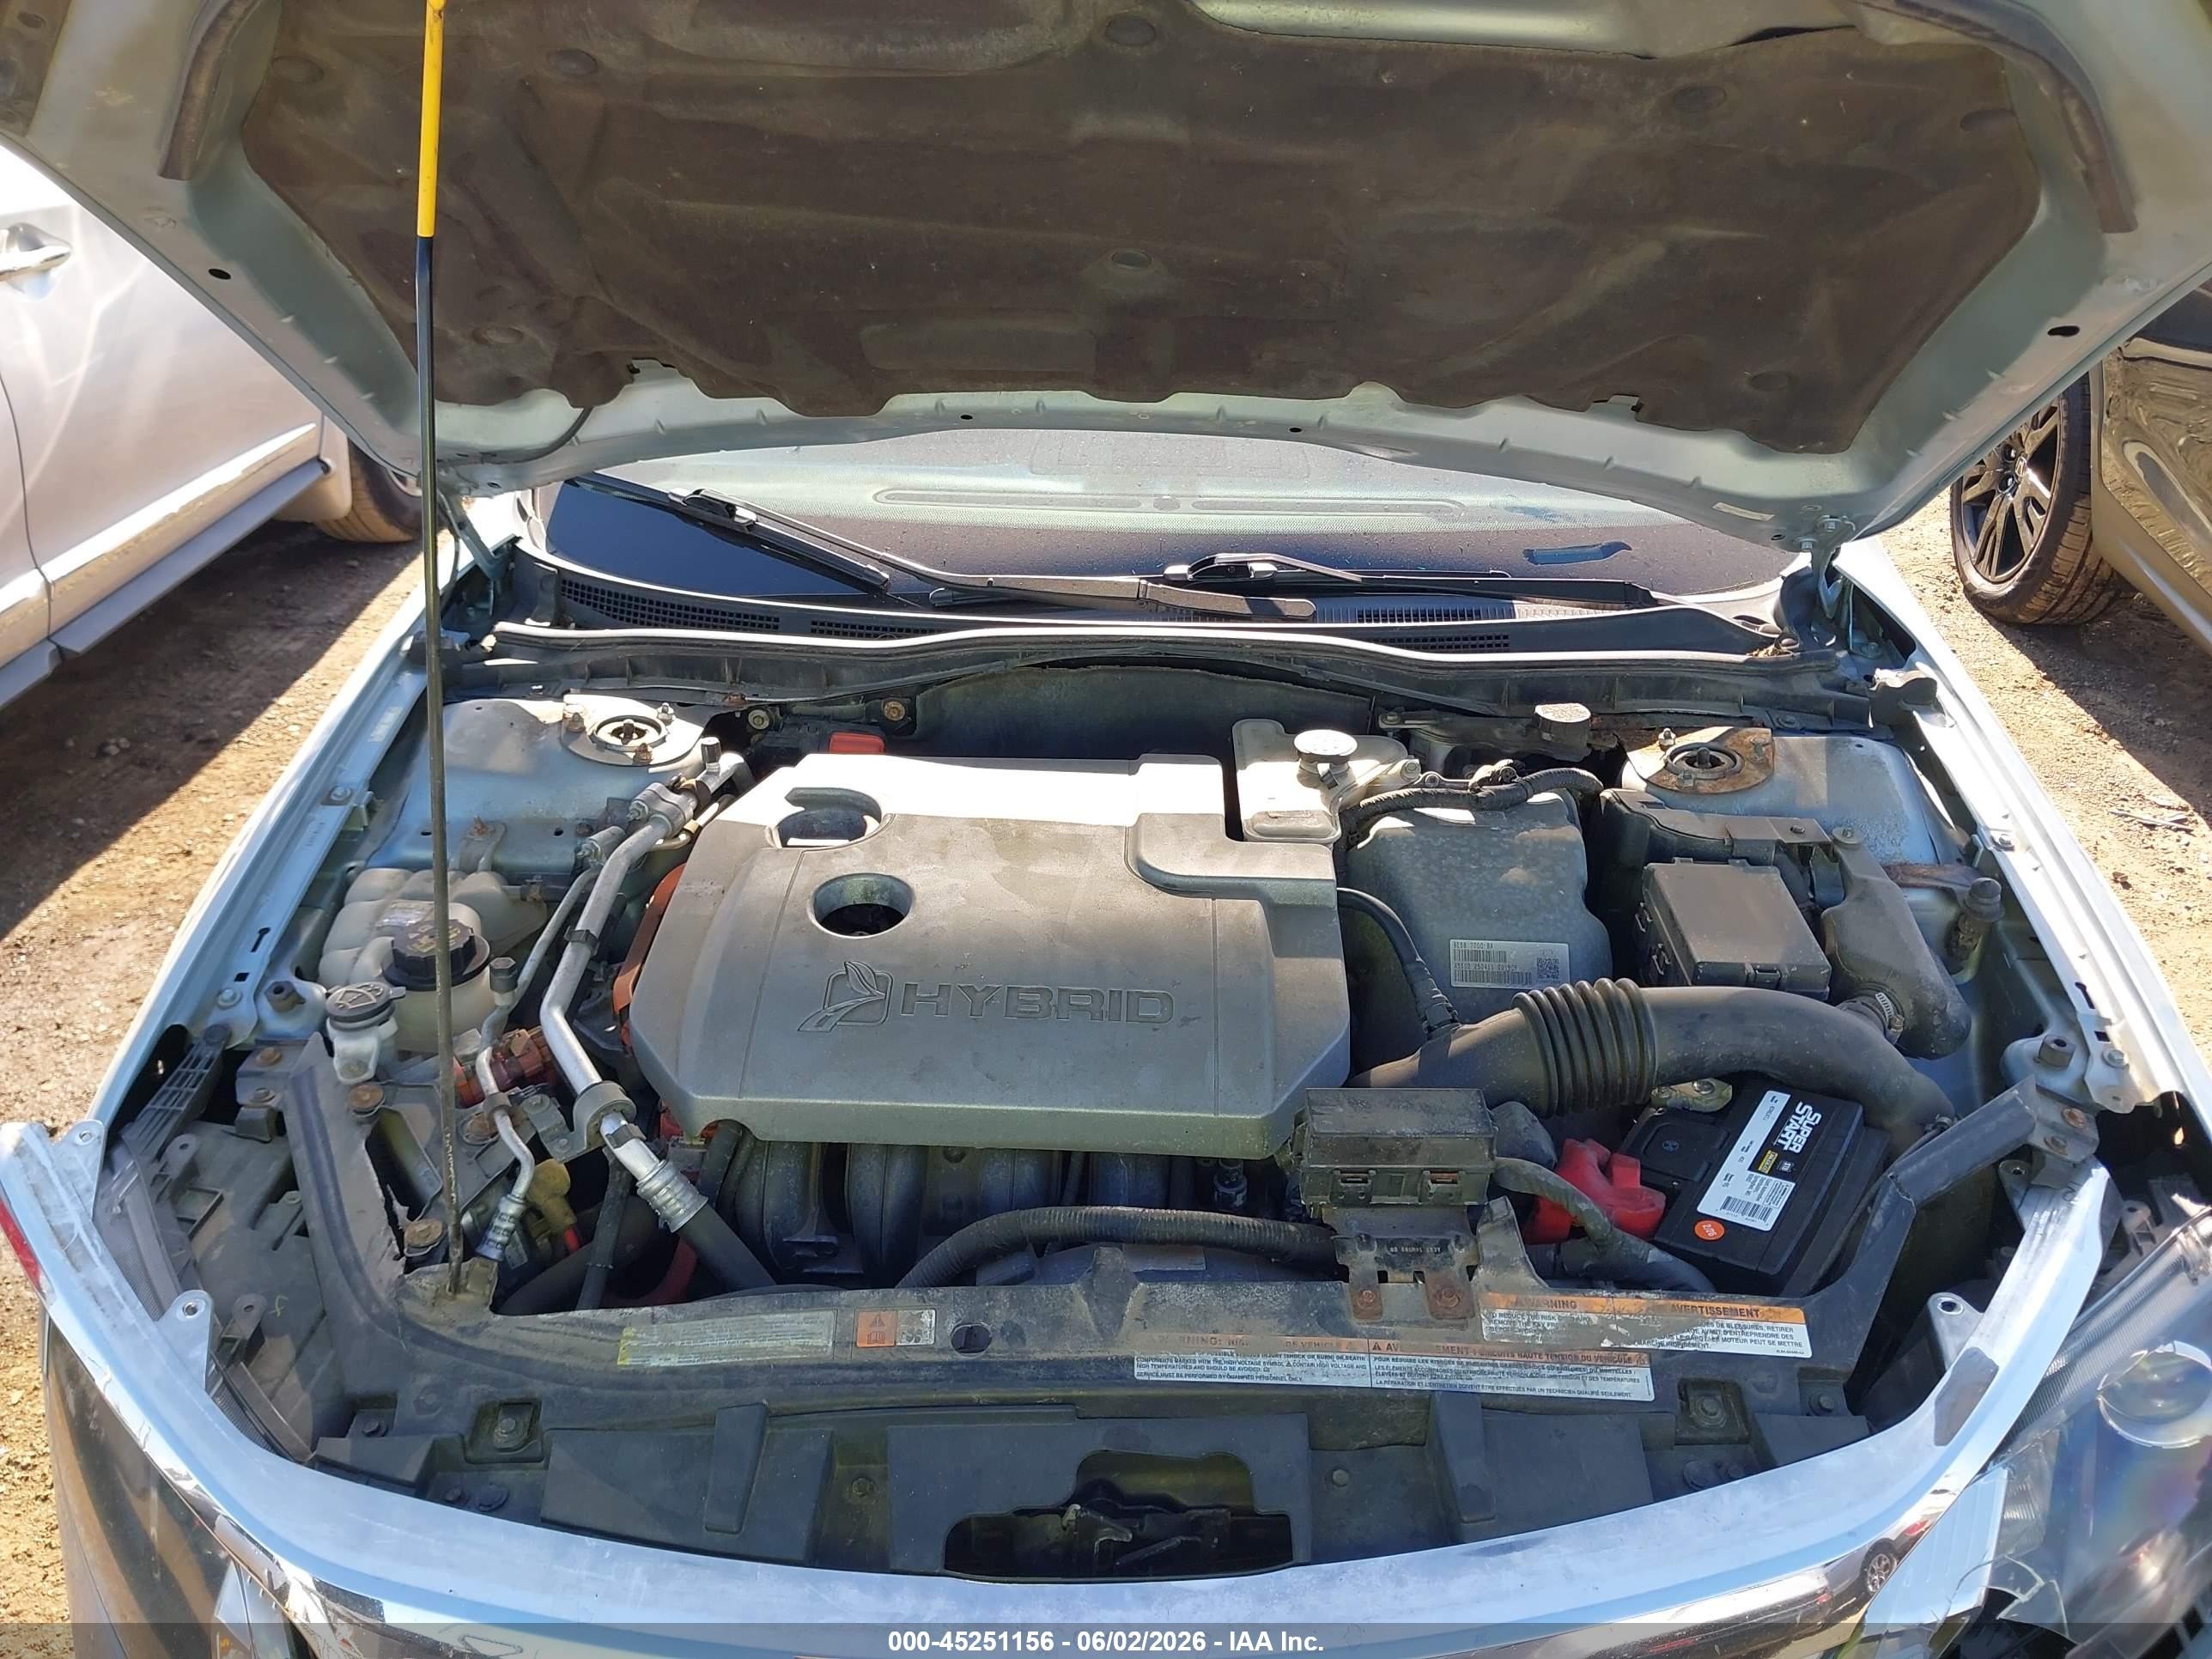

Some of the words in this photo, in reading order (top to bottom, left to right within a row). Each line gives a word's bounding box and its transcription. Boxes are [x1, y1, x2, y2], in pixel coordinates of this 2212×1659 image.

[900, 981, 1175, 1024] HYBRID
[1779, 1101, 1812, 1151] START
[1787, 1111, 1822, 1153] SUPER
[1701, 1223, 1718, 1237] 2/26
[1721, 1336, 1748, 1345] MOTEUR
[1581, 1353, 1592, 1363] DU
